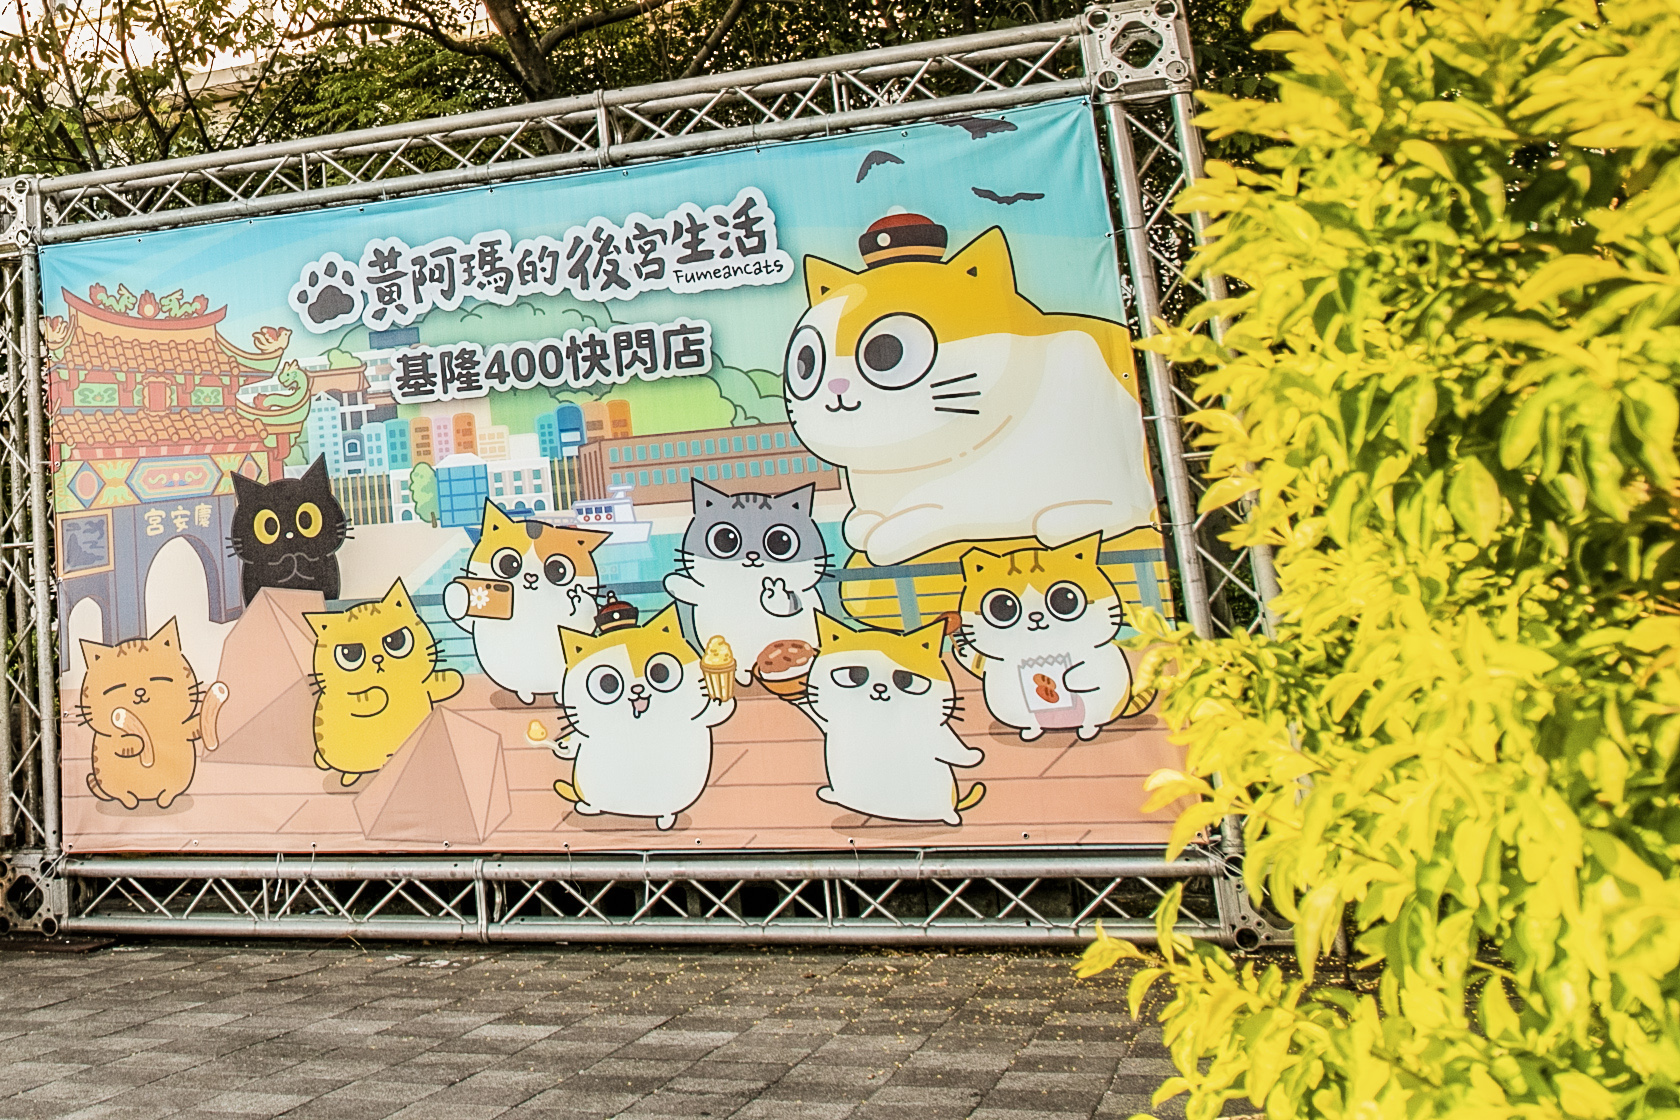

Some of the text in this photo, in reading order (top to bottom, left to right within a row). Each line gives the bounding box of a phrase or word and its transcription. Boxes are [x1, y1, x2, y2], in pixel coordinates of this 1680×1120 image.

[365, 196, 768, 320] 黃阿瑪的後宮生活
[673, 259, 784, 284] Fumeancats
[395, 324, 706, 397] 基隆400快閃店
